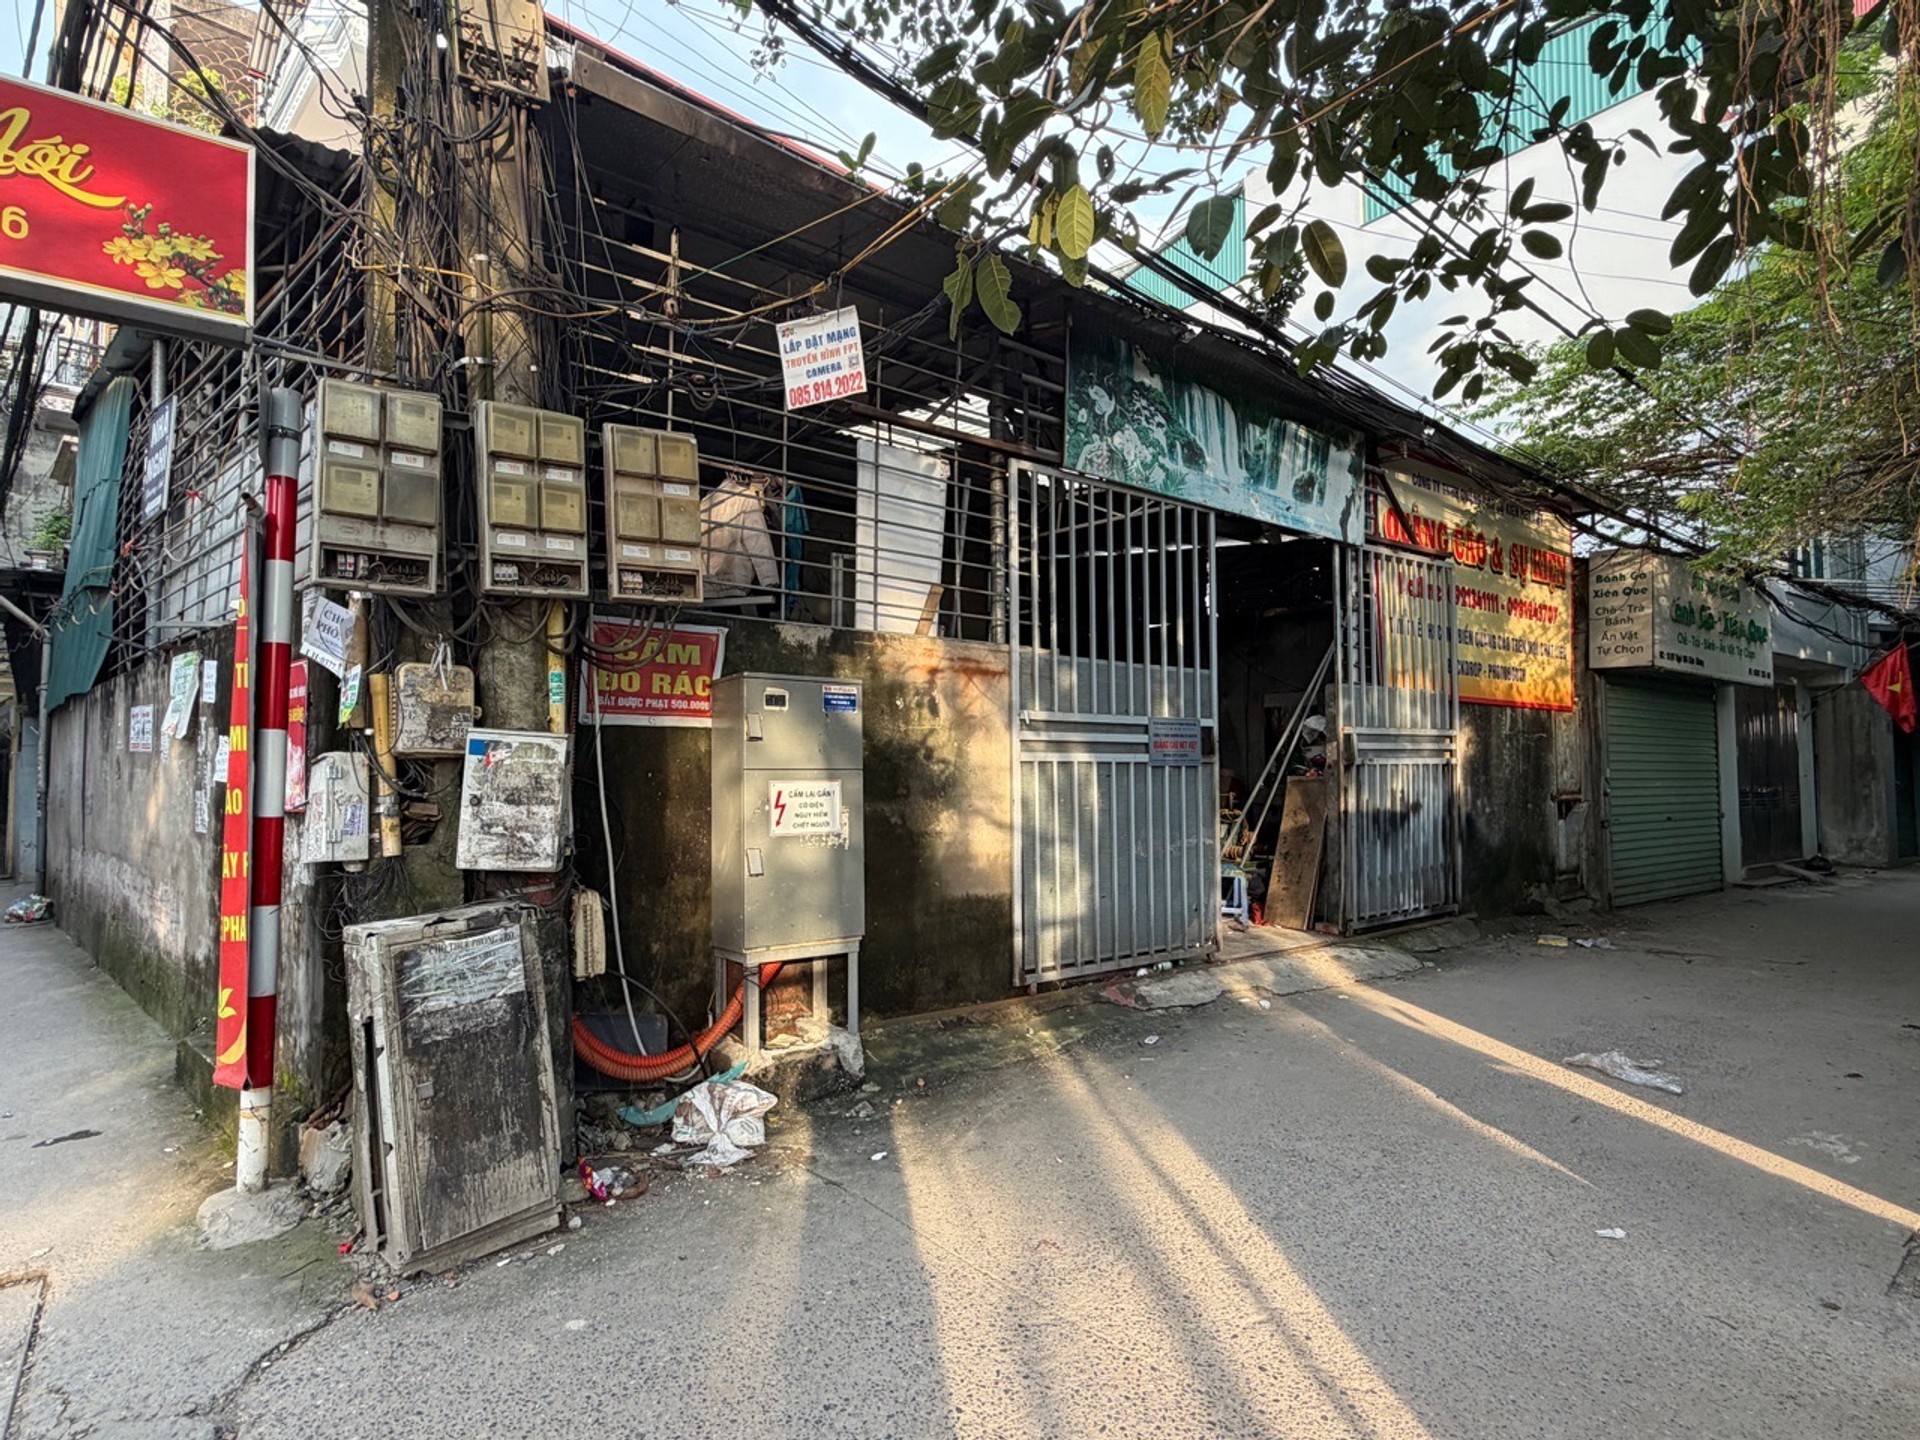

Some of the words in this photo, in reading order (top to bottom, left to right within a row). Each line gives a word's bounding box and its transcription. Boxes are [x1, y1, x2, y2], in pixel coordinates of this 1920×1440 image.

[826, 327, 857, 343] MẠNG
[843, 342, 859, 355] FPT
[805, 361, 843, 379] CAMERA
[789, 371, 864, 407] 085.814.2022
[1605, 616, 1634, 627] Bánh
[1620, 631, 1639, 642] Vặt
[1596, 646, 1611, 656] Tự
[1614, 644, 1644, 655] Chọn
[652, 671, 711, 697] RÁC
